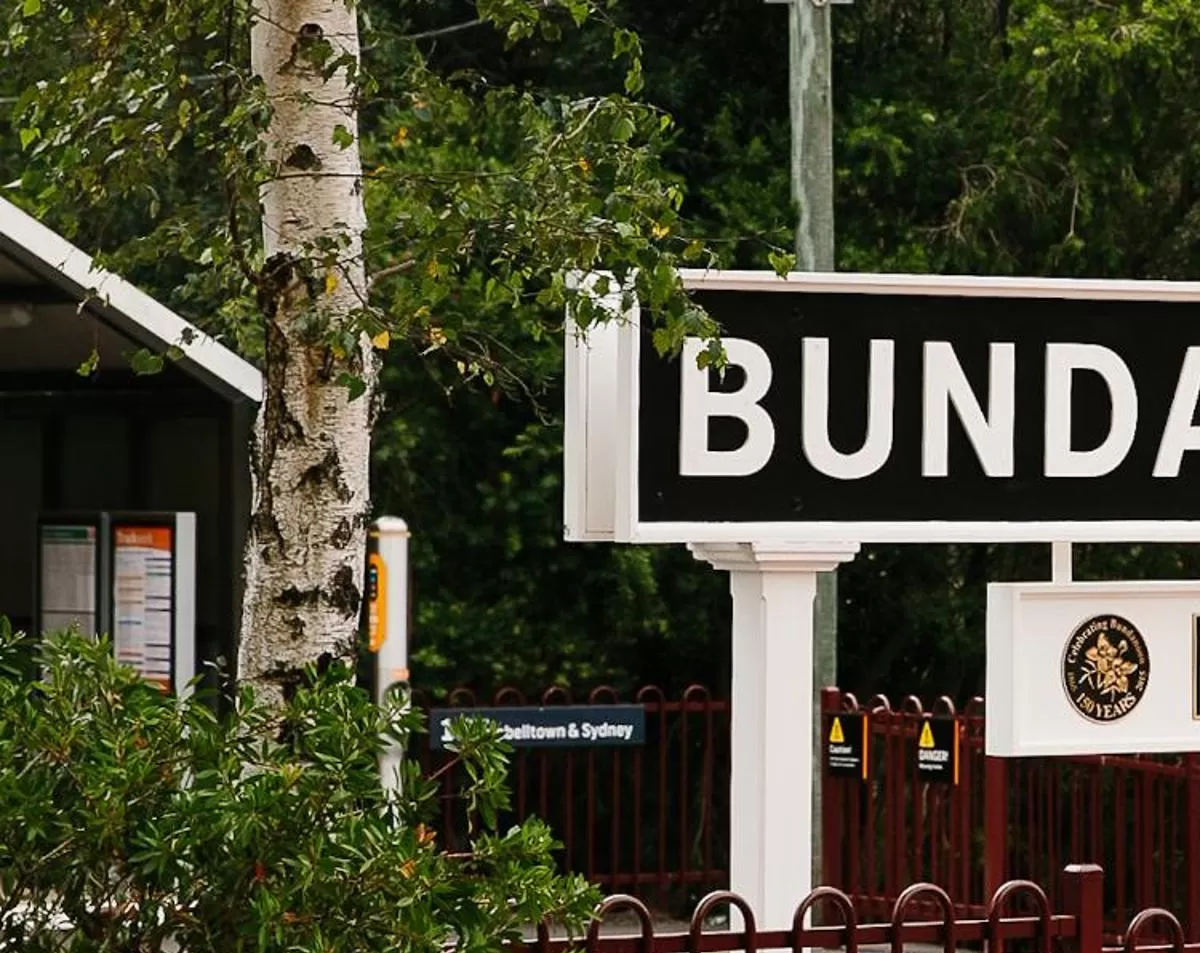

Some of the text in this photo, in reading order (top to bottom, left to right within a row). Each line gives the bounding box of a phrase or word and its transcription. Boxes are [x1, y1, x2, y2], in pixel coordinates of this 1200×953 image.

[1095, 692, 1137, 718] YEARS
[503, 721, 634, 741] belltown & Sydney
